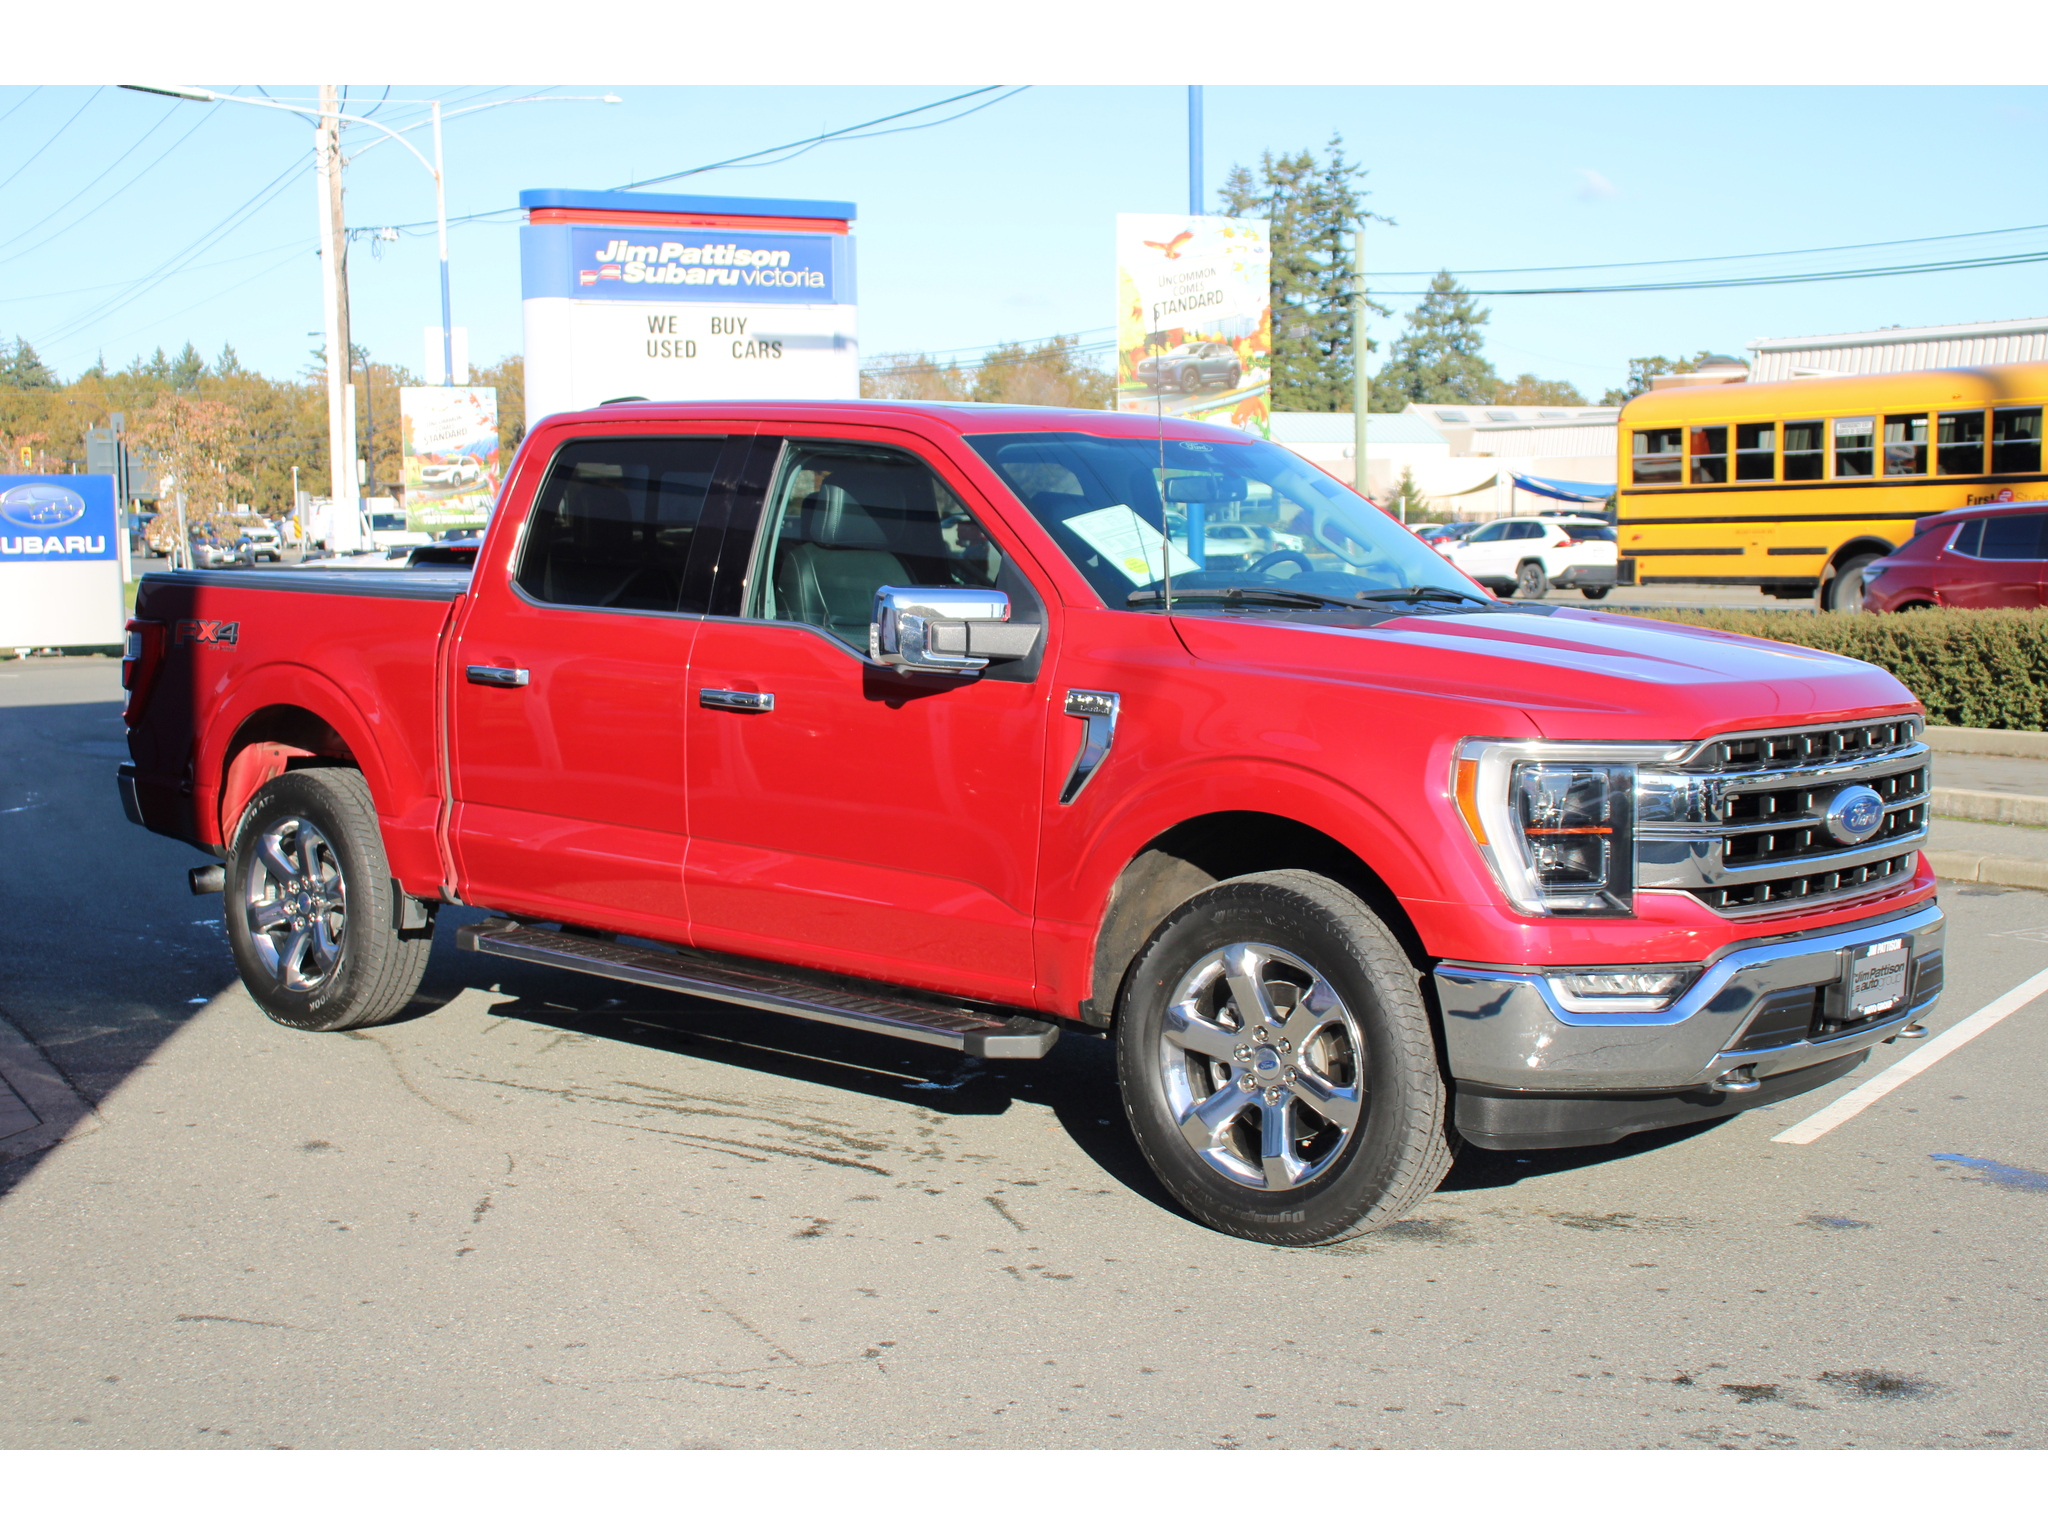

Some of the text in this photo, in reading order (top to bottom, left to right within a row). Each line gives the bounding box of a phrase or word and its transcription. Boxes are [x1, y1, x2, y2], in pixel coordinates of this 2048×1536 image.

[595, 240, 791, 267] Jim Pattison
[622, 261, 741, 286] Subaru
[1158, 267, 1217, 288] UNCOMMON
[1172, 280, 1205, 297] COMES
[1153, 289, 1224, 320] STANDARD
[647, 315, 748, 336] WE BUY
[646, 339, 783, 360] USED CARS
[423, 427, 468, 446] STANDARD
[1966, 491, 2048, 506] First Stud
[0, 535, 105, 555] UBARU
[174, 618, 241, 648] FX4
[1851, 802, 1882, 828] Ford
[1854, 962, 1905, 984] Jim Pattison
